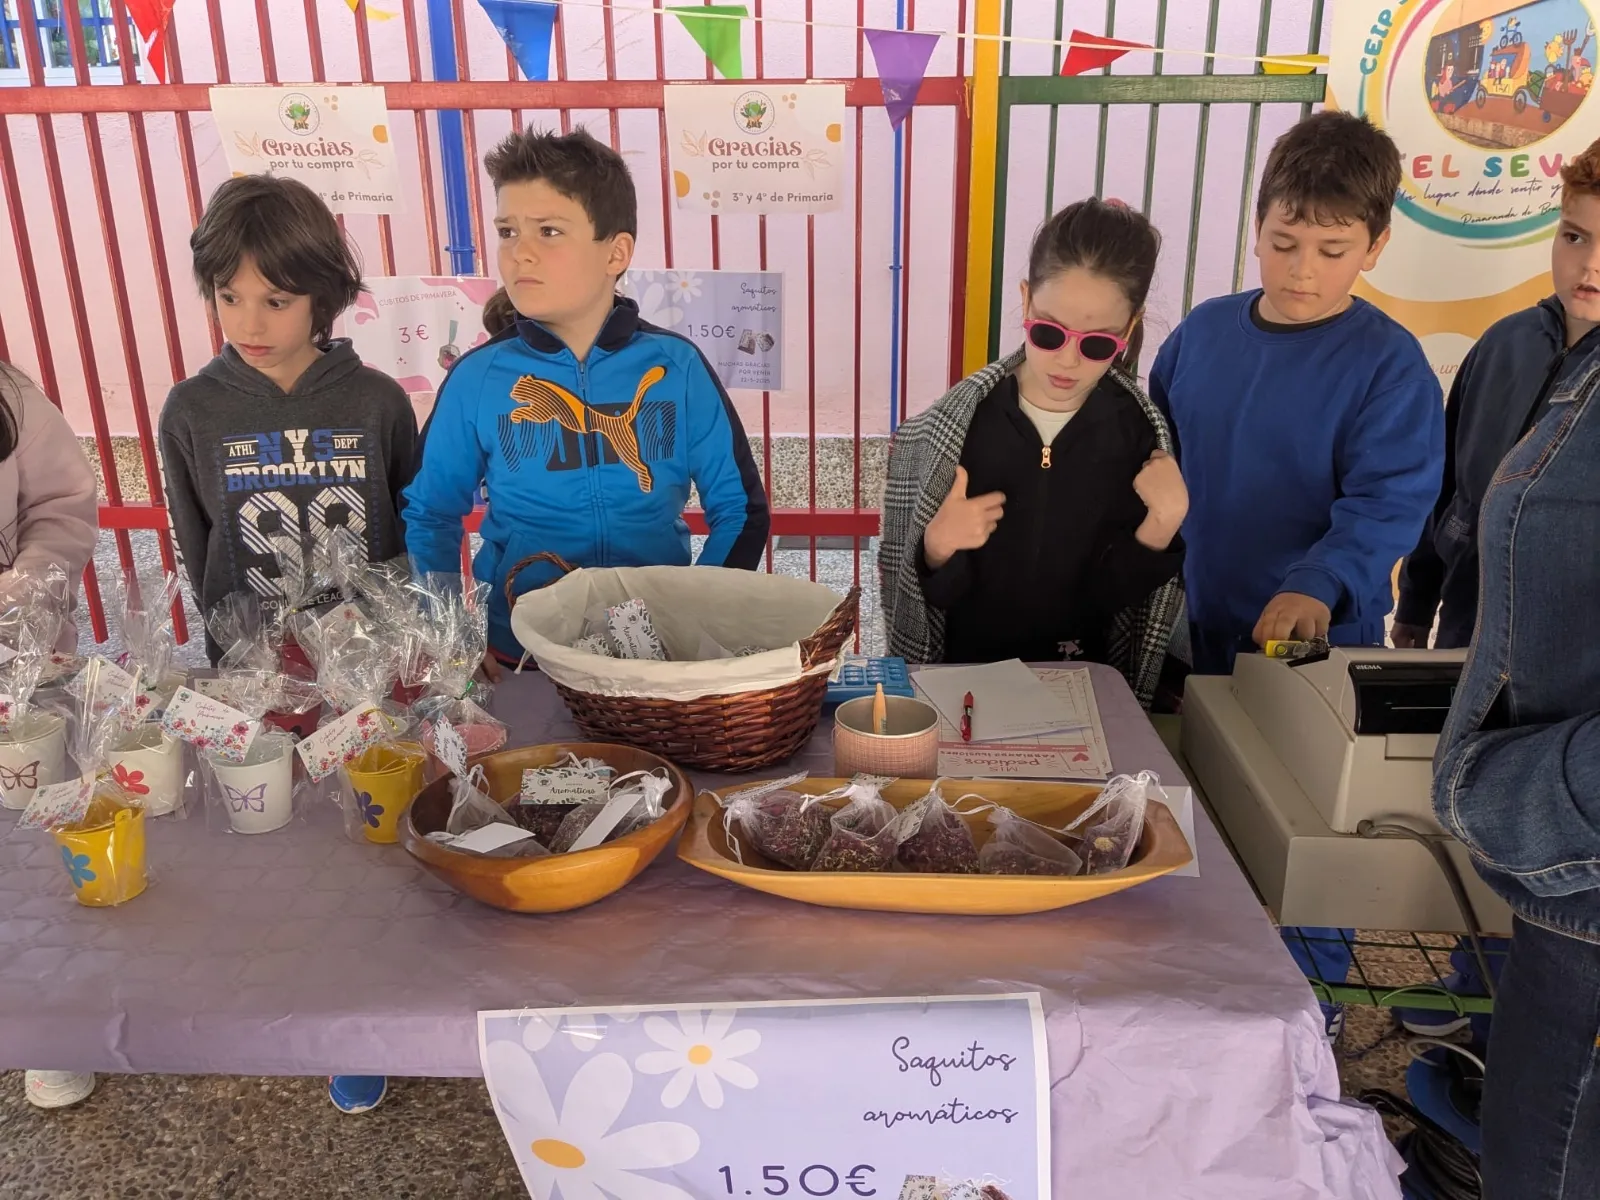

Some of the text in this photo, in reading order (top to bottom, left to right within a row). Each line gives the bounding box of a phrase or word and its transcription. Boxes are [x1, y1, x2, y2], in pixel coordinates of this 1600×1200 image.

[1360, 9, 1392, 75] CEIP
[261, 137, 354, 157] Gracias
[708, 136, 802, 157] Gracias
[269, 161, 354, 172] por tu compra
[712, 160, 800, 172] por tu compra
[1483, 153, 1580, 179] SEV
[331, 191, 345, 201] de
[348, 192, 394, 202] Primaria
[746, 195, 753, 204] y
[770, 192, 784, 202] de
[787, 192, 834, 202] Primaria
[410, 294, 420, 302] DE
[398, 327, 411, 343] 3
[228, 428, 359, 464] ATHL NYS DEPT
[224, 460, 367, 492] BROOKLYN
[890, 1036, 1017, 1087] Saquitos
[863, 1097, 1019, 1129] aromáticos
[717, 1163, 878, 1198] 1.50€
